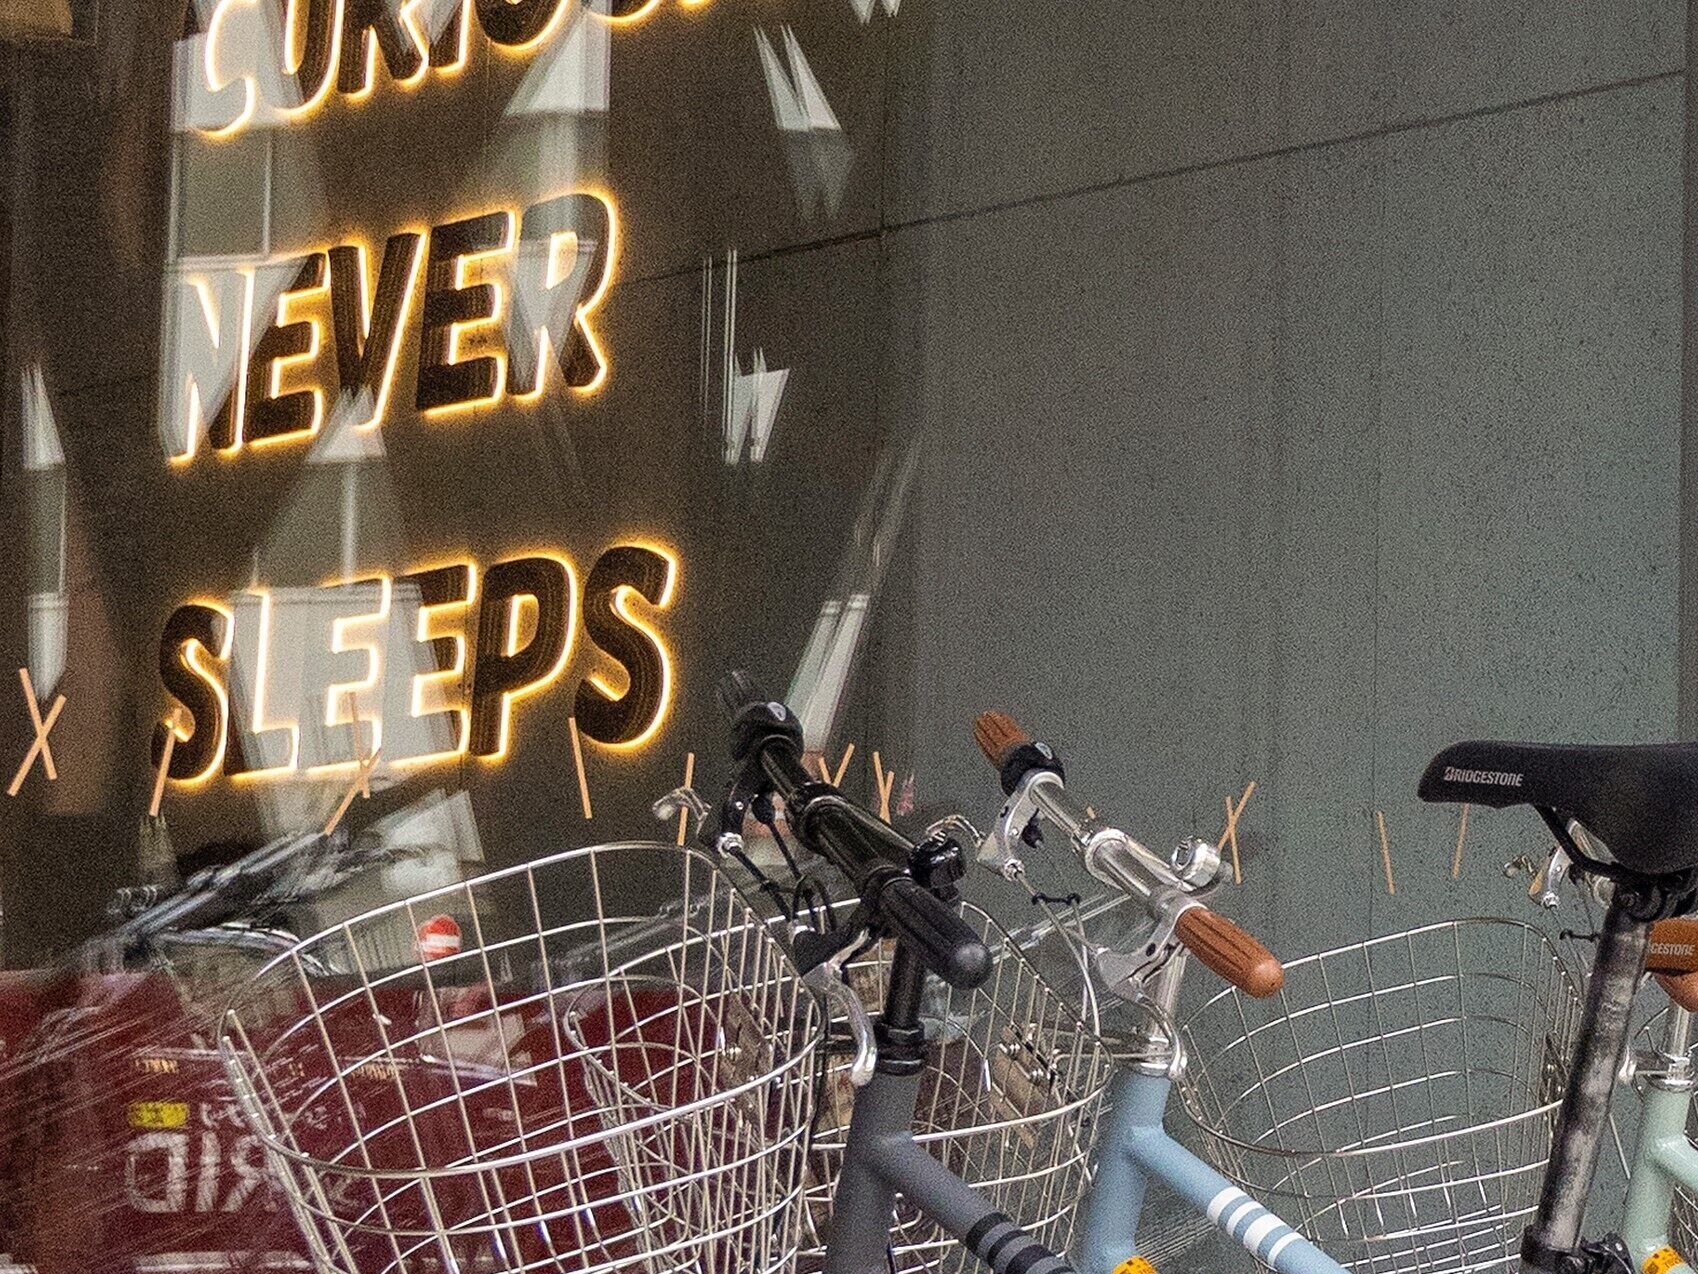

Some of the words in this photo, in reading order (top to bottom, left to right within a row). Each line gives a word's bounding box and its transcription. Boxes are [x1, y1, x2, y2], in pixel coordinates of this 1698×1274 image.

[162, 190, 617, 464] NEVER
[153, 545, 676, 782] SLEEPS
[1444, 766, 1524, 787] BRIDGESTONE
